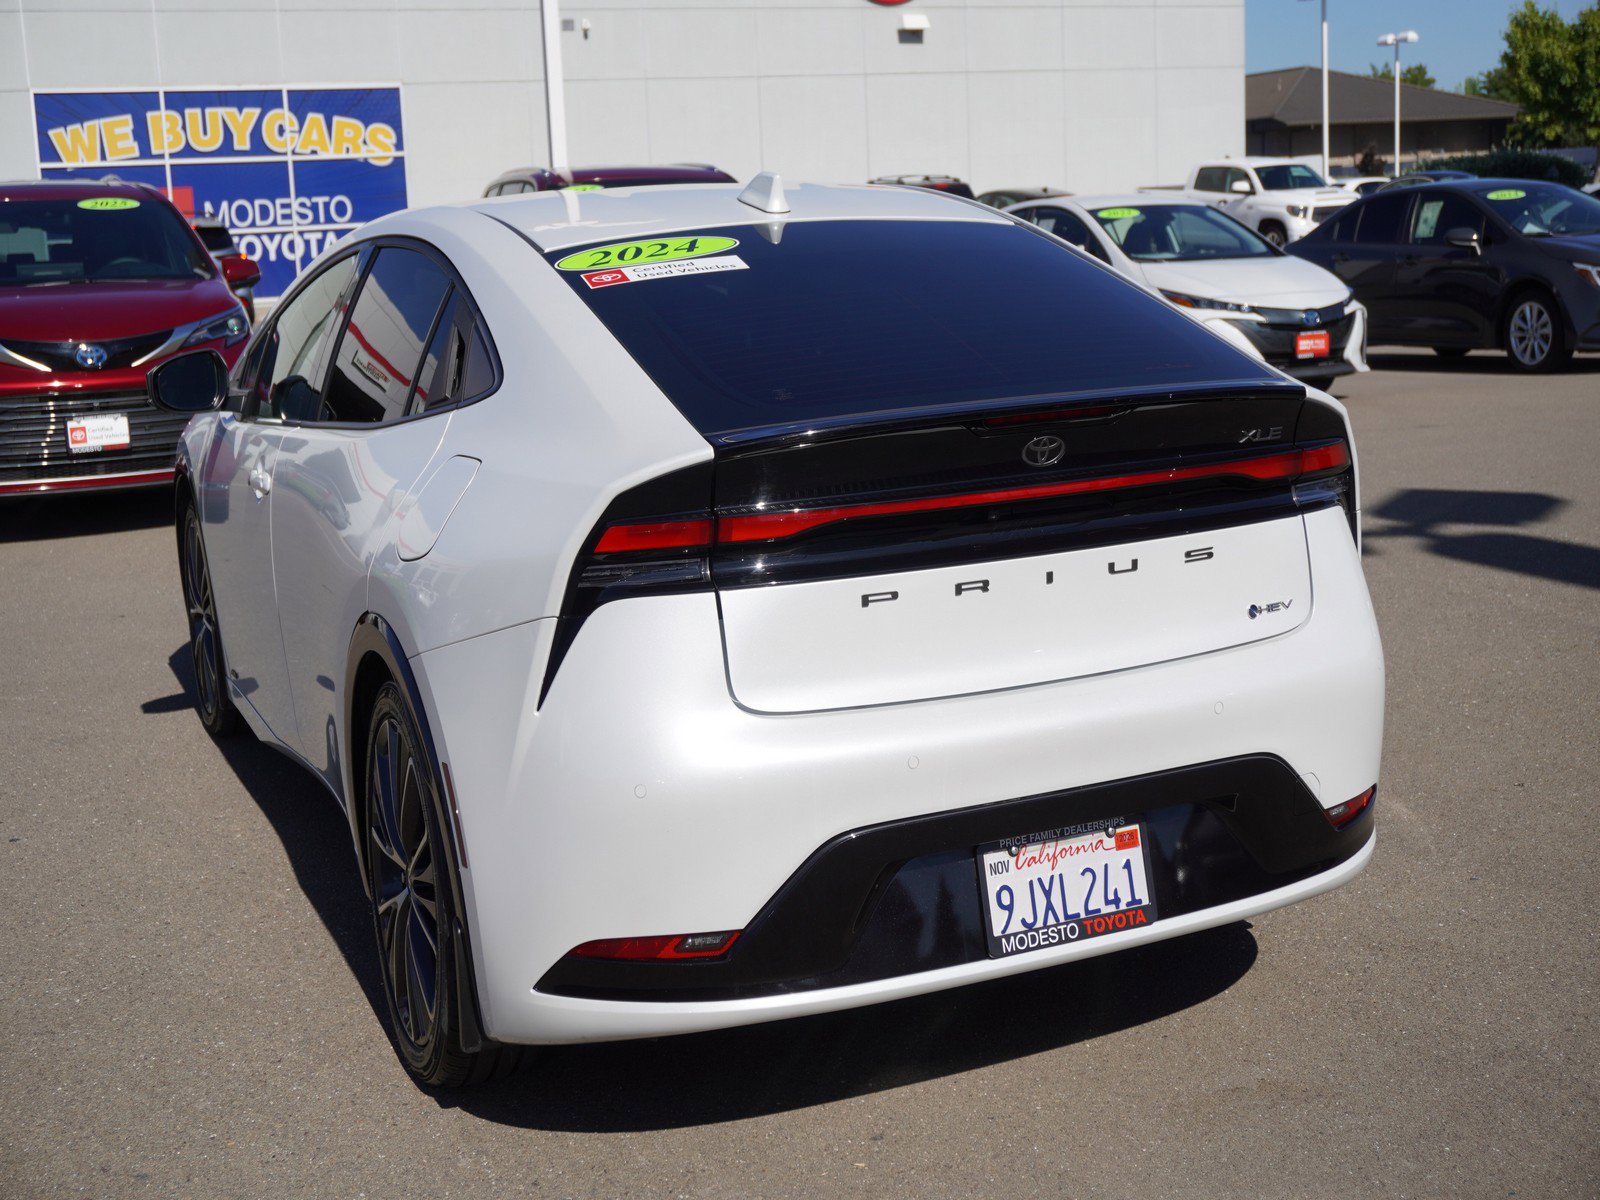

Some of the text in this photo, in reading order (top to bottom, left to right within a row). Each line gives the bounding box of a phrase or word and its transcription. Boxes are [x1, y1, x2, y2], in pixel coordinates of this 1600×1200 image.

[47, 106, 397, 167] WE BUY CARS
[203, 194, 354, 229] MODESTO
[586, 237, 700, 267] 2024
[632, 261, 695, 273] Certified
[636, 264, 737, 279] Used Vehicles
[1239, 426, 1283, 443] XLE
[861, 546, 1215, 608] PRIUS
[1000, 817, 1126, 849] PRICE FAMILY DEALERSHIPS
[989, 860, 1010, 876] NOV
[1015, 837, 1116, 871] California
[995, 858, 1142, 935] 9JXL241
[1001, 909, 1147, 953] MODESTO TOYOTA
